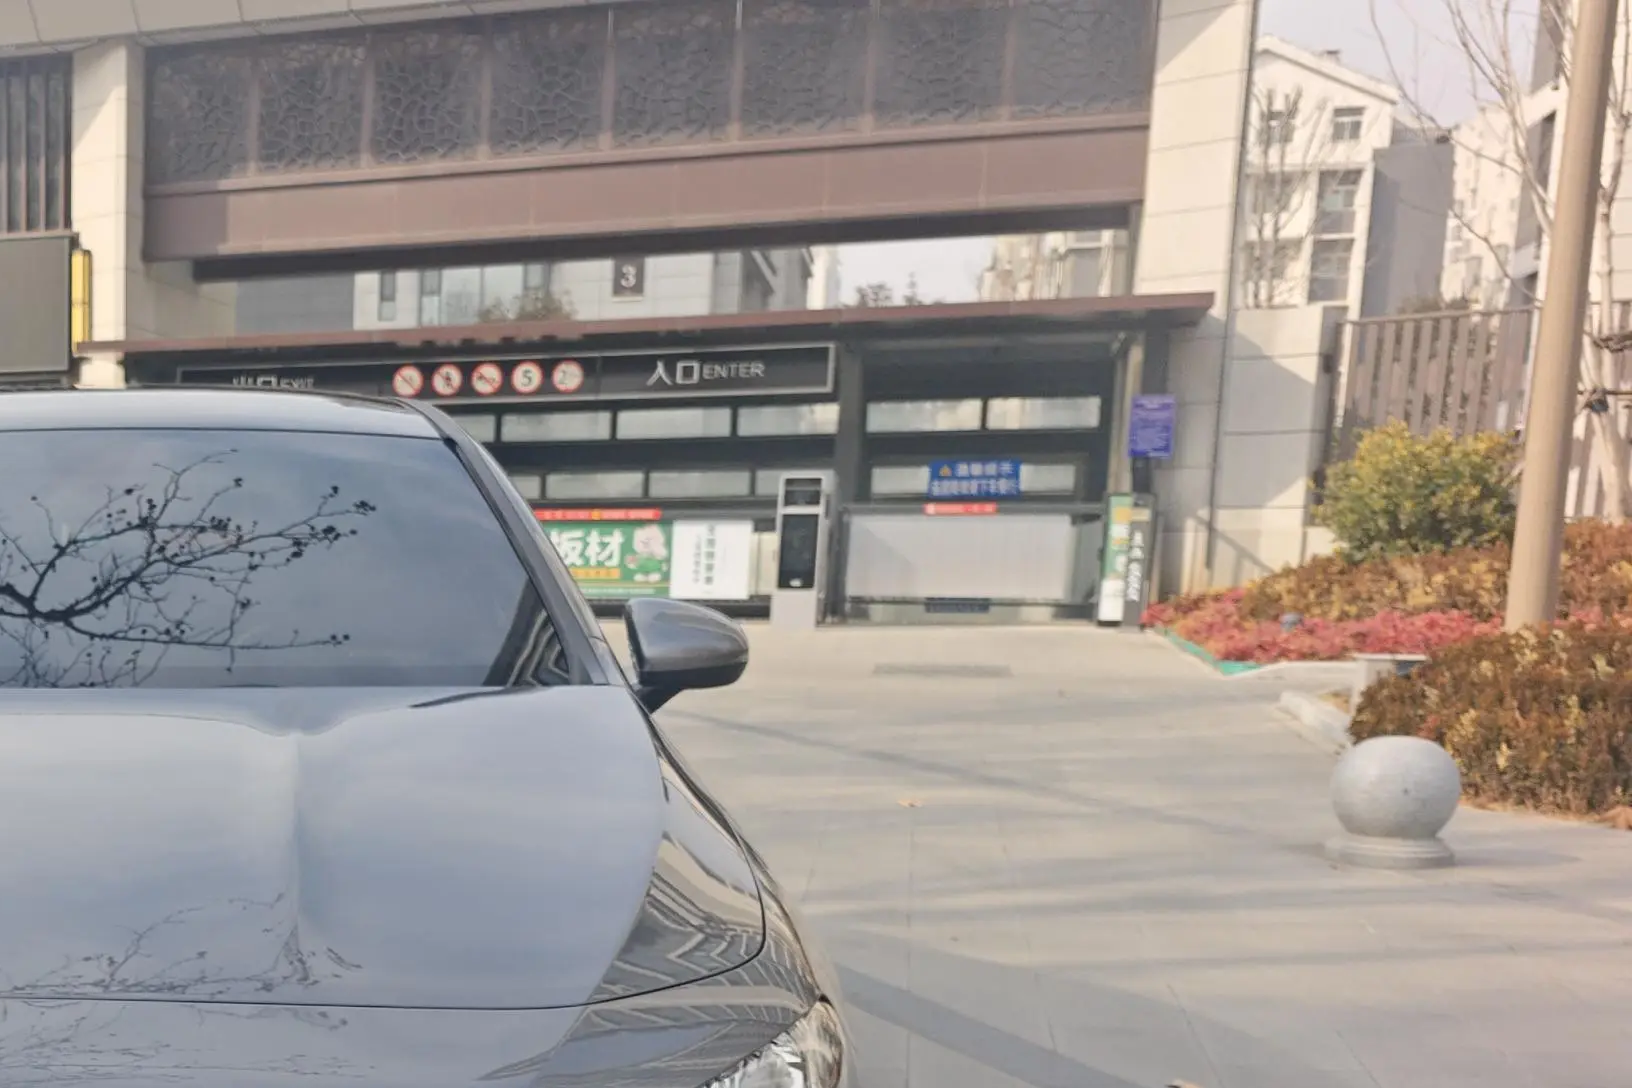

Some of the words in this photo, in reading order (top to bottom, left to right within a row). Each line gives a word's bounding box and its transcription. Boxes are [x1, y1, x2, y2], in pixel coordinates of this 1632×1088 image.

[621, 264, 637, 288] 3
[520, 368, 533, 387] 5
[646, 360, 701, 386] 入口
[702, 361, 766, 380] ENTER
[550, 528, 625, 567] 板材
